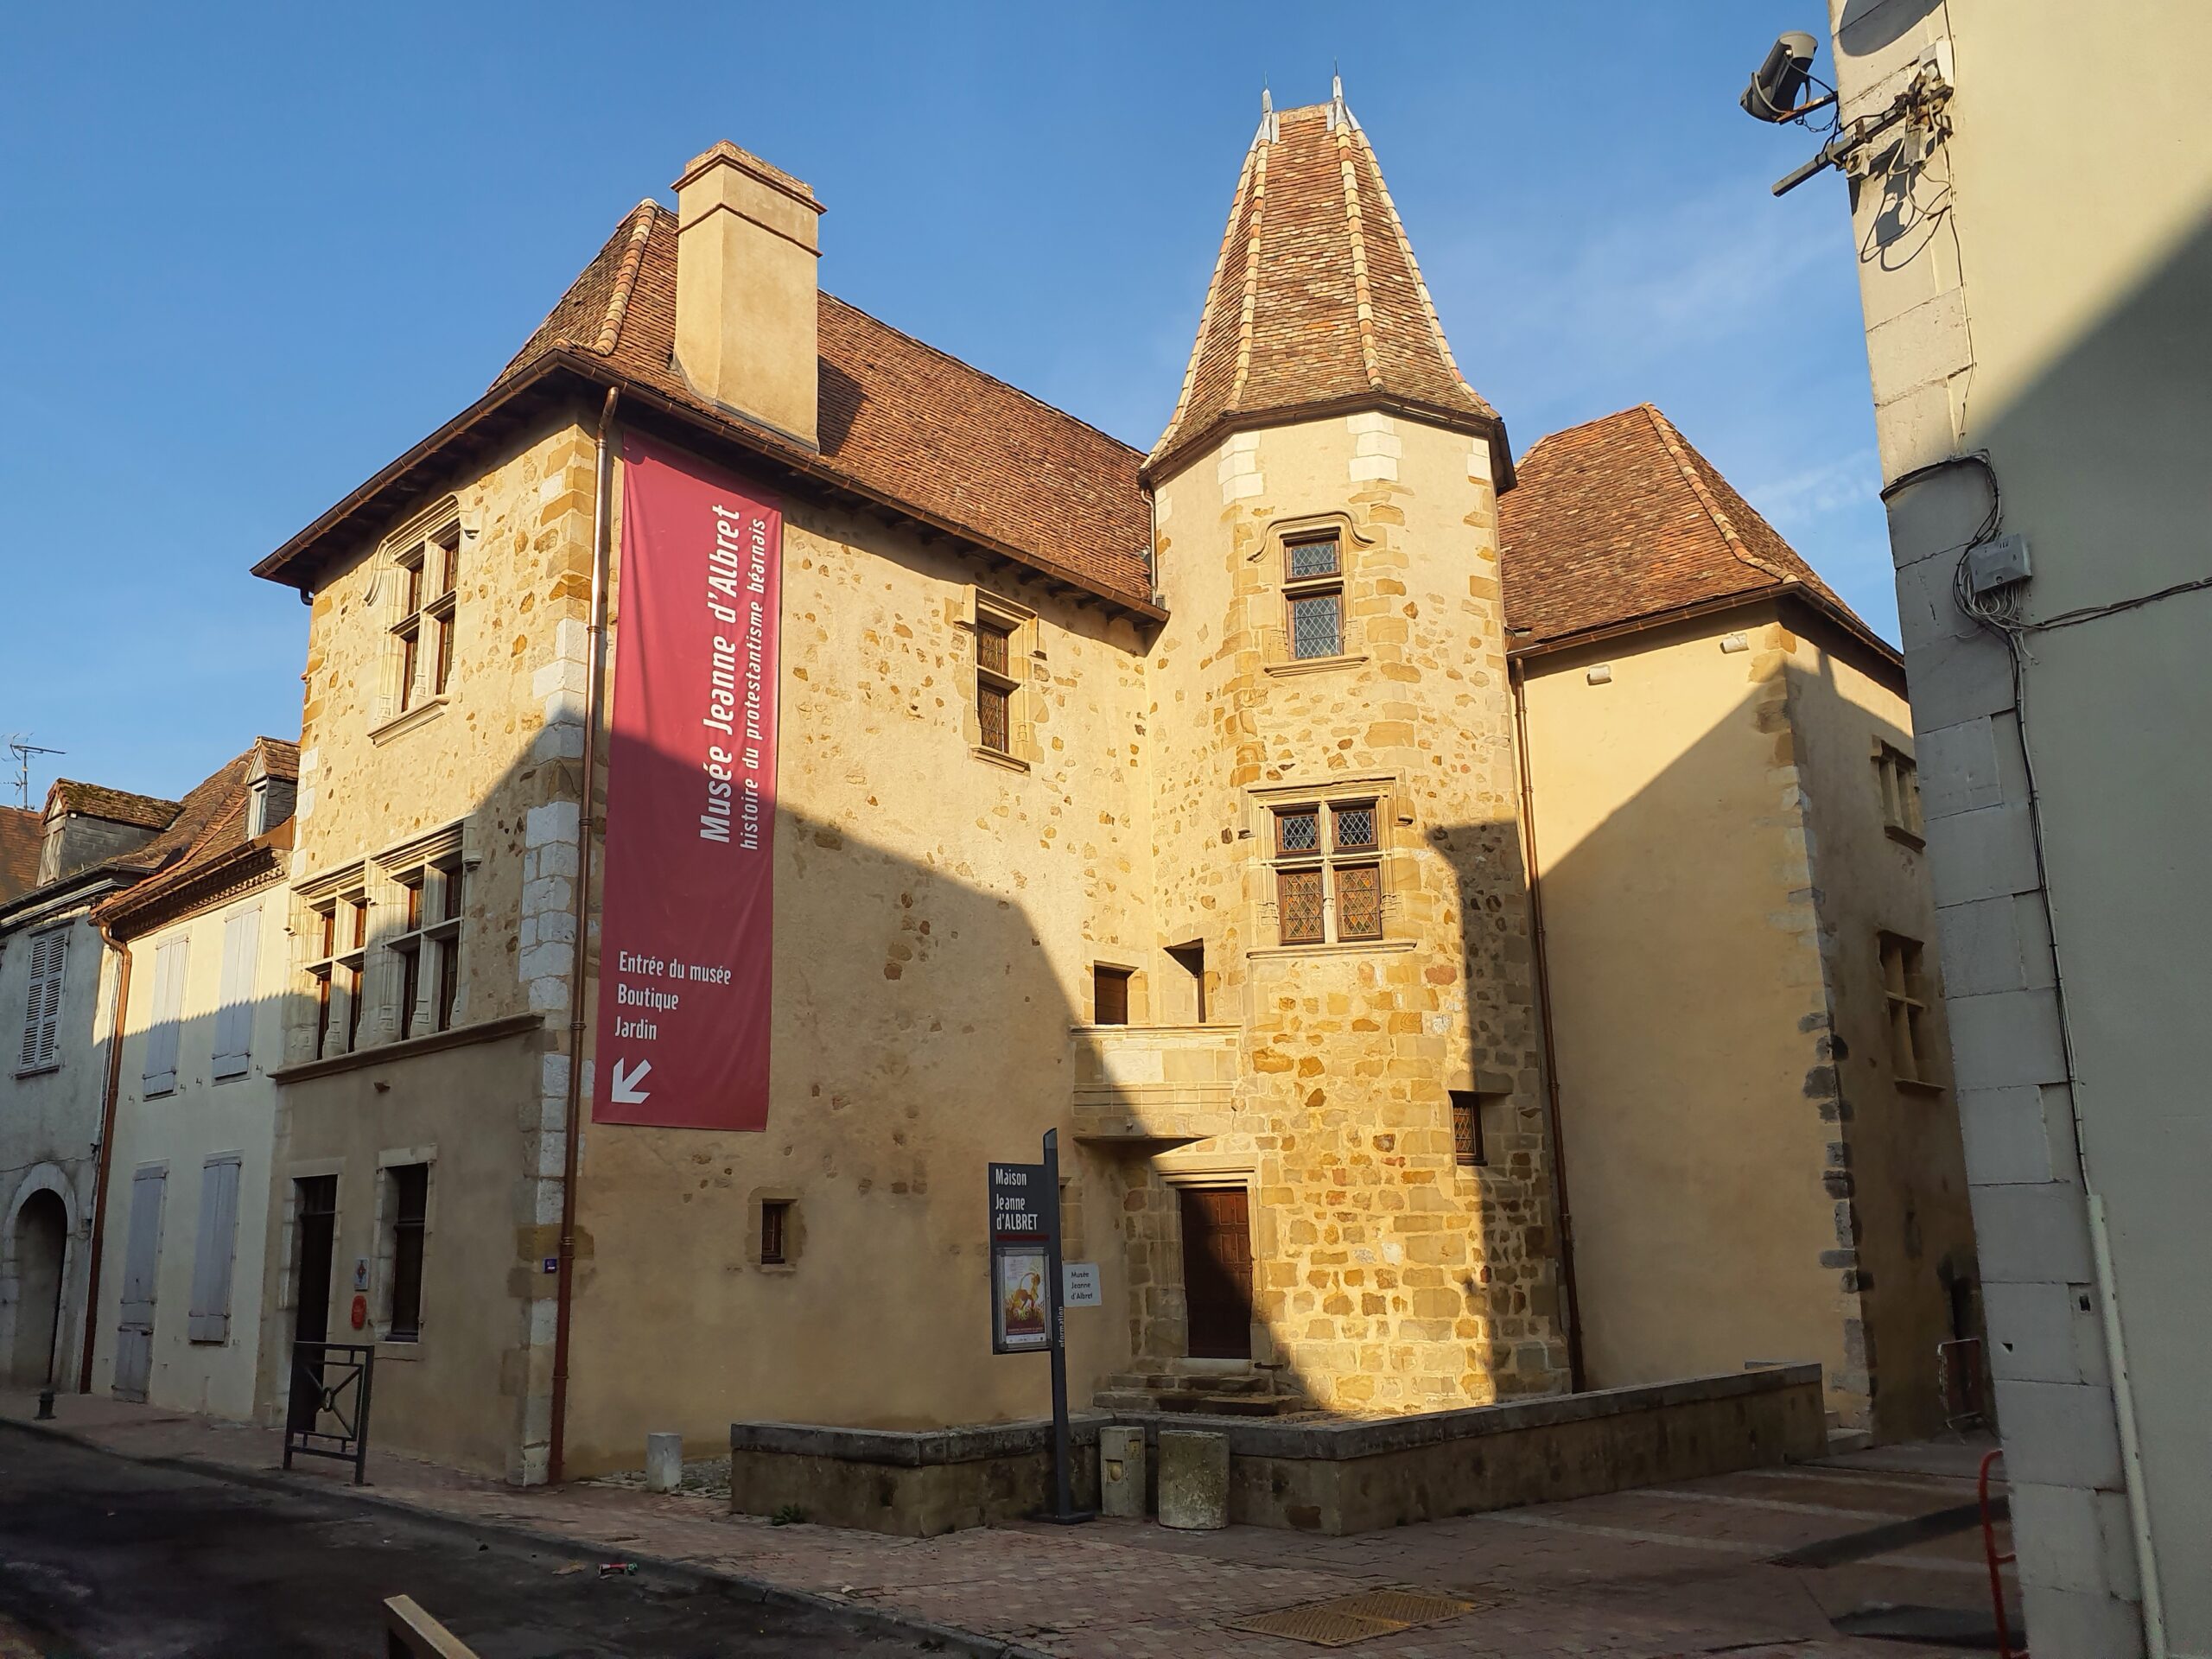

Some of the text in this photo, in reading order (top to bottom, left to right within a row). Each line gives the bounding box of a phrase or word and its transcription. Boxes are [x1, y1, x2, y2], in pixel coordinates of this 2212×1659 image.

[700, 505, 740, 843] Musée Jeanne d'Albret
[740, 518, 766, 850] histoire du protestantisme béarnais
[619, 950, 732, 985] Entrée du musée
[618, 983, 679, 1013] Boutique
[614, 1016, 658, 1040] Jardin
[995, 1168, 1027, 1186] Maison
[995, 1193, 1026, 1211] Jeanne
[996, 1213, 1038, 1230] d'ALBRET
[1071, 1292, 1093, 1300] d'Albret
